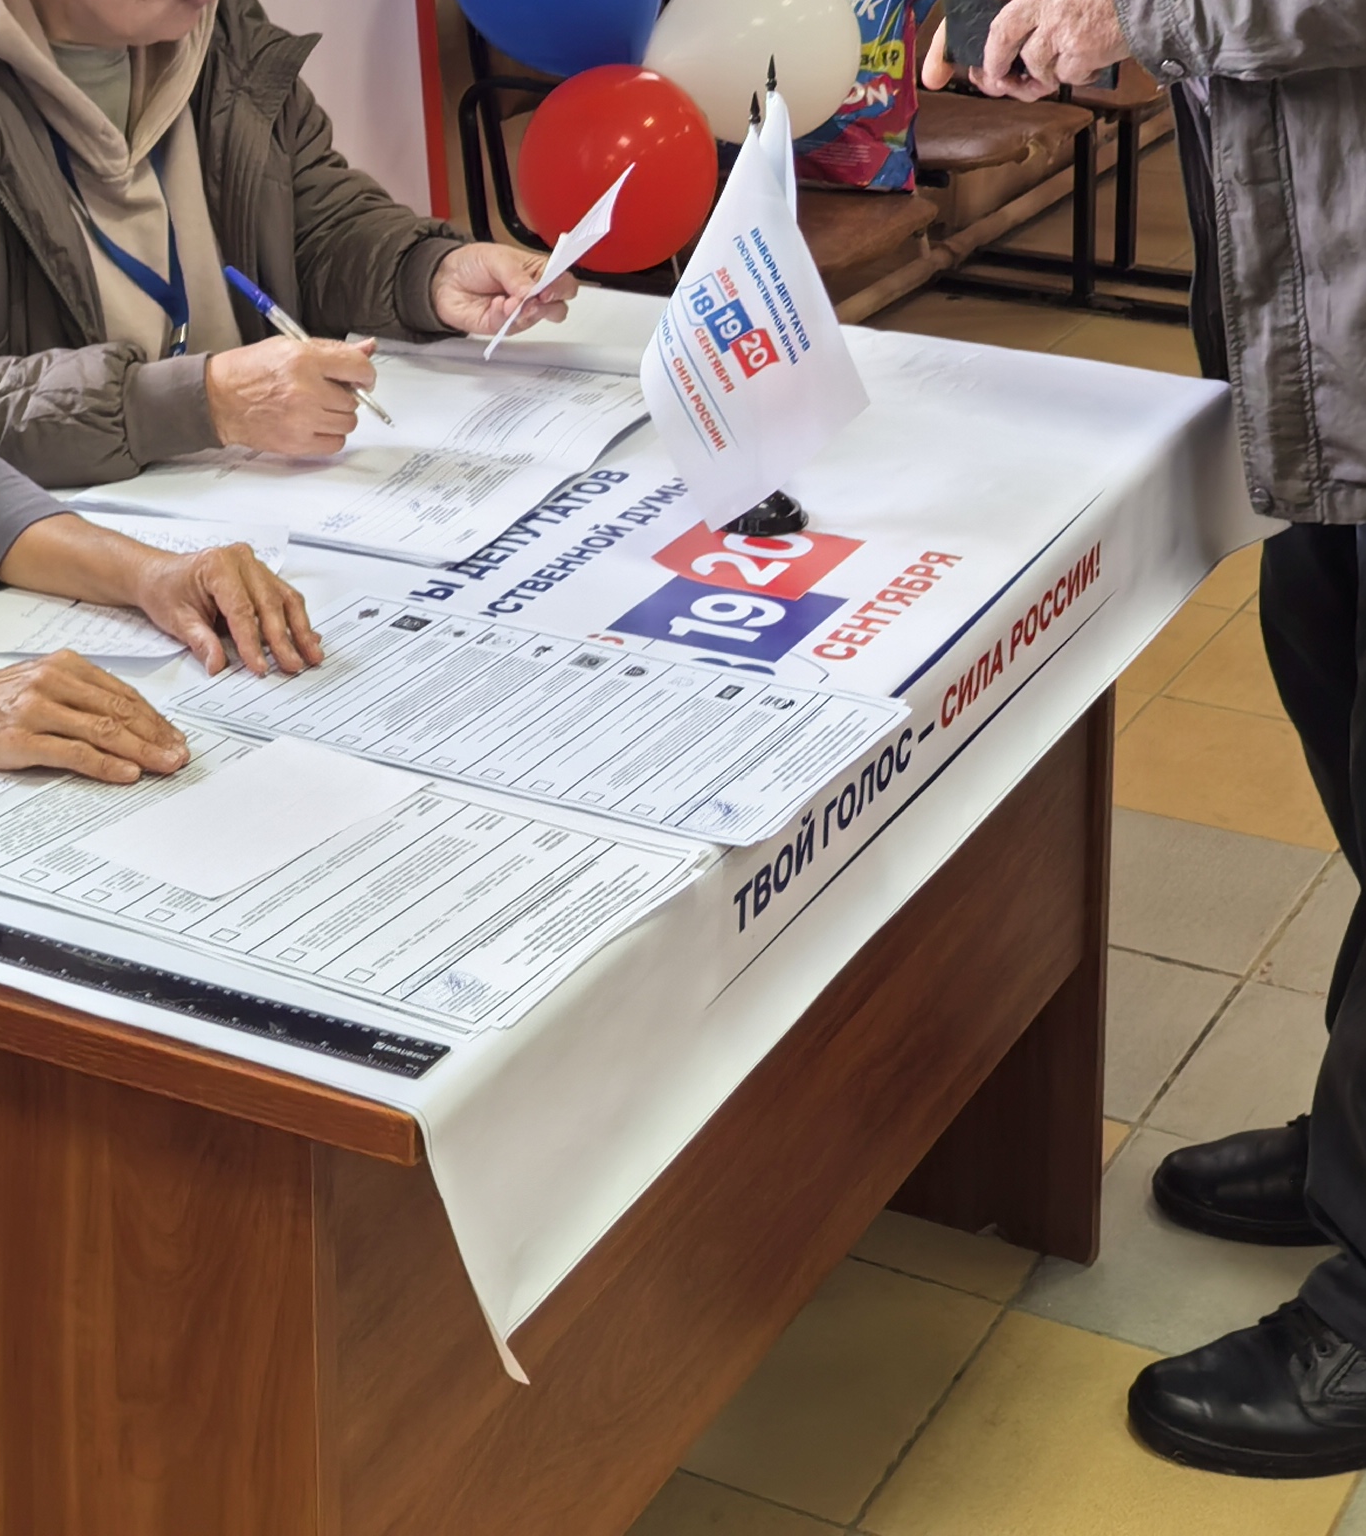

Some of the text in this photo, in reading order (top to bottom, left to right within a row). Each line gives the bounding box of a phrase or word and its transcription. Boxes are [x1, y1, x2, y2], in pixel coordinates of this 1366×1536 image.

[688, 284, 716, 317] 18
[715, 266, 740, 299] 2026
[732, 234, 800, 367] ГОСУДАРСТВЕННОЙ ДУМЫ
[749, 226, 812, 352] ВЫБОРЫ ДЕПУТАТОВ
[713, 306, 743, 340] 19
[738, 331, 769, 370] 20
[694, 327, 735, 394] СЕНТЯБРЯ
[672, 356, 693, 395] СИЛА
[690, 393, 728, 453] РОССИИ!
[452, 468, 630, 581] ДЕПУТАТОВ
[691, 533, 815, 586] 20
[668, 592, 787, 644] 19
[811, 550, 963, 662] СЕНТЯБРЯ
[733, 815, 816, 934] ТВОЙ
[822, 726, 913, 850] ГОЛОС
[939, 646, 1003, 730] СИЛА
[1008, 539, 1103, 665] РОССИИ!
